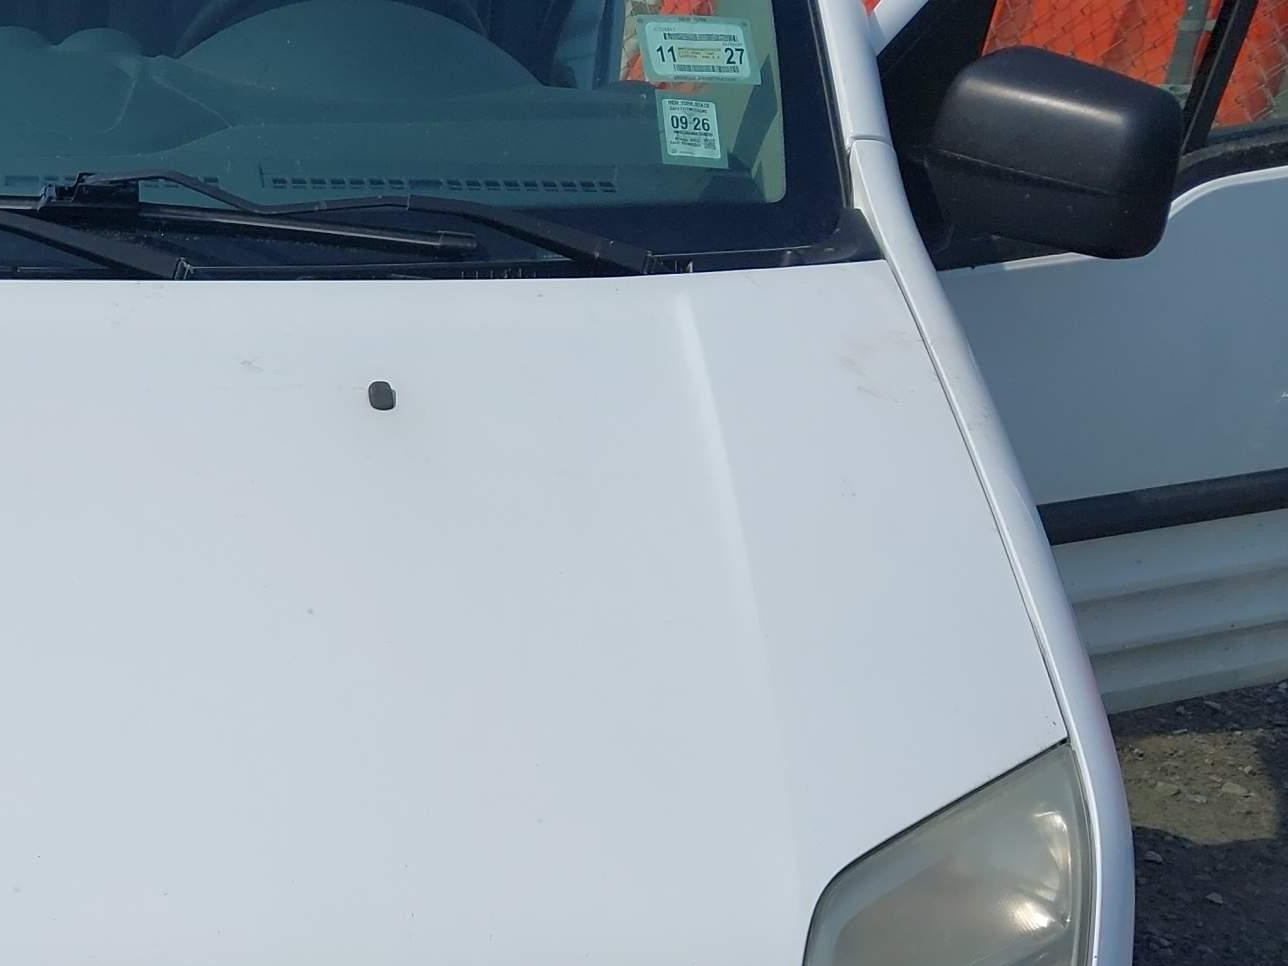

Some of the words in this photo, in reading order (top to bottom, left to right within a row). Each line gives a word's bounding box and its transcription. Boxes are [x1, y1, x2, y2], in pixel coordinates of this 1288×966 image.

[656, 45, 677, 63] 11
[724, 47, 745, 65] 27
[670, 115, 688, 130] 09
[692, 116, 710, 132] 26
